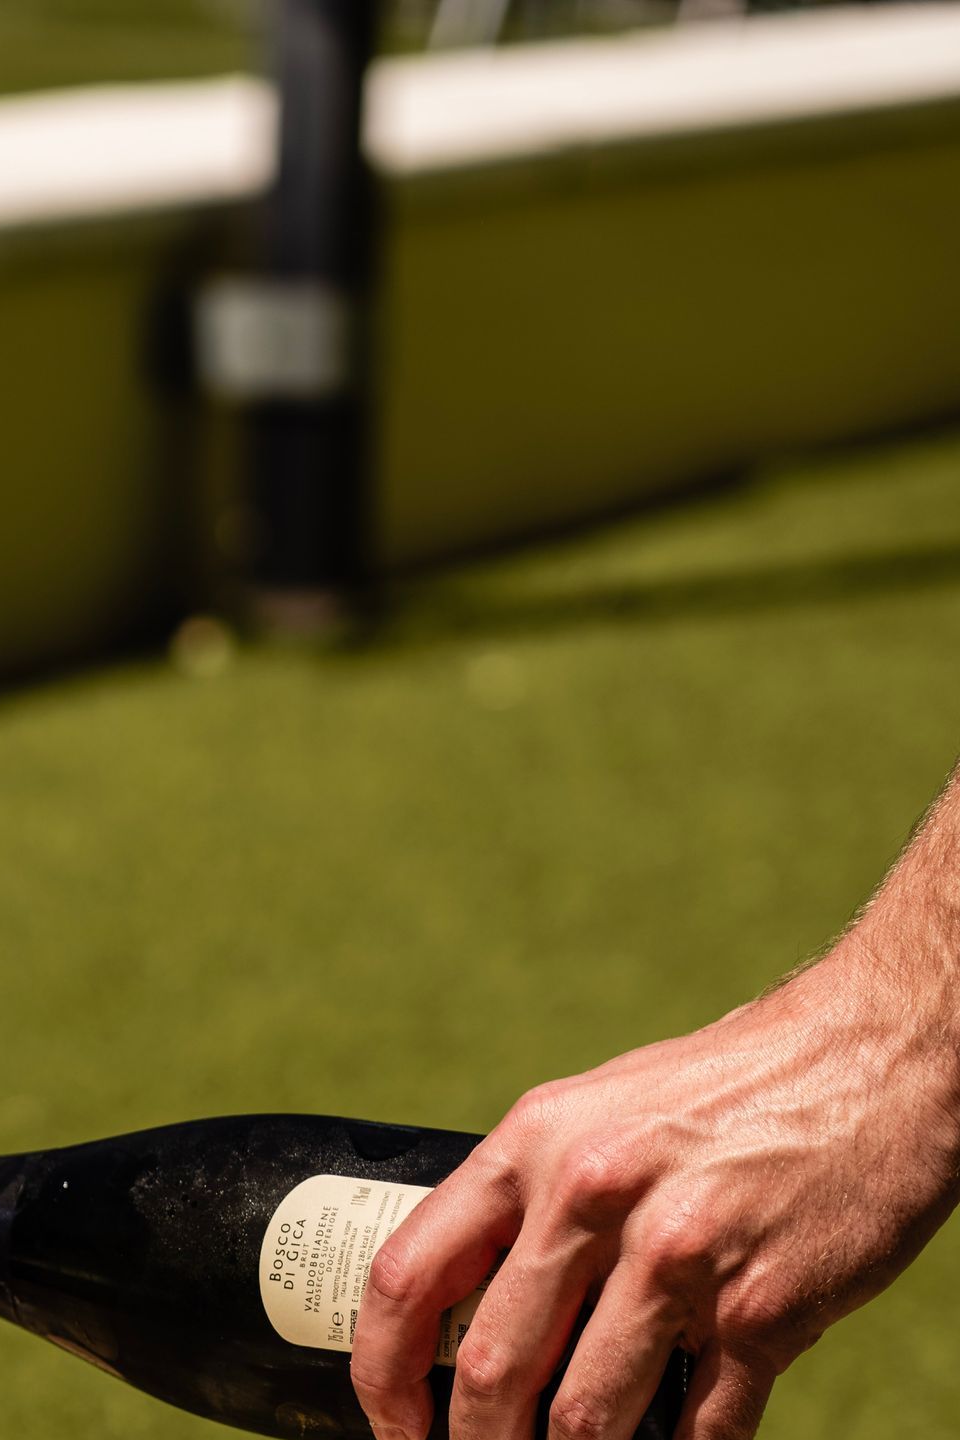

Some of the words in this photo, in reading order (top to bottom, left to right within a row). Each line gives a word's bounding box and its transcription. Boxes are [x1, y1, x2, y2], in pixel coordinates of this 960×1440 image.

[286, 1219, 307, 1261] GICA
[350, 1228, 358, 1242] ITALIA
[360, 1235, 370, 1249] kcal
[269, 1223, 291, 1281] BOSCO
[300, 1243, 309, 1268] BRUT
[304, 1205, 331, 1311] VALDOBBIADENE
[314, 1262, 325, 1312] PROSECCO
[320, 1207, 339, 1258] SUPERIORE
[326, 1246, 337, 1272] DOCG
[337, 1250, 345, 1266] ADAMI
[343, 1250, 353, 1277] PRODOTTO
[283, 1272, 295, 1290] DI
[336, 1266, 342, 1274] DA
[332, 1275, 341, 1302] PRODOTTO
[340, 1281, 348, 1297] ITALIA
